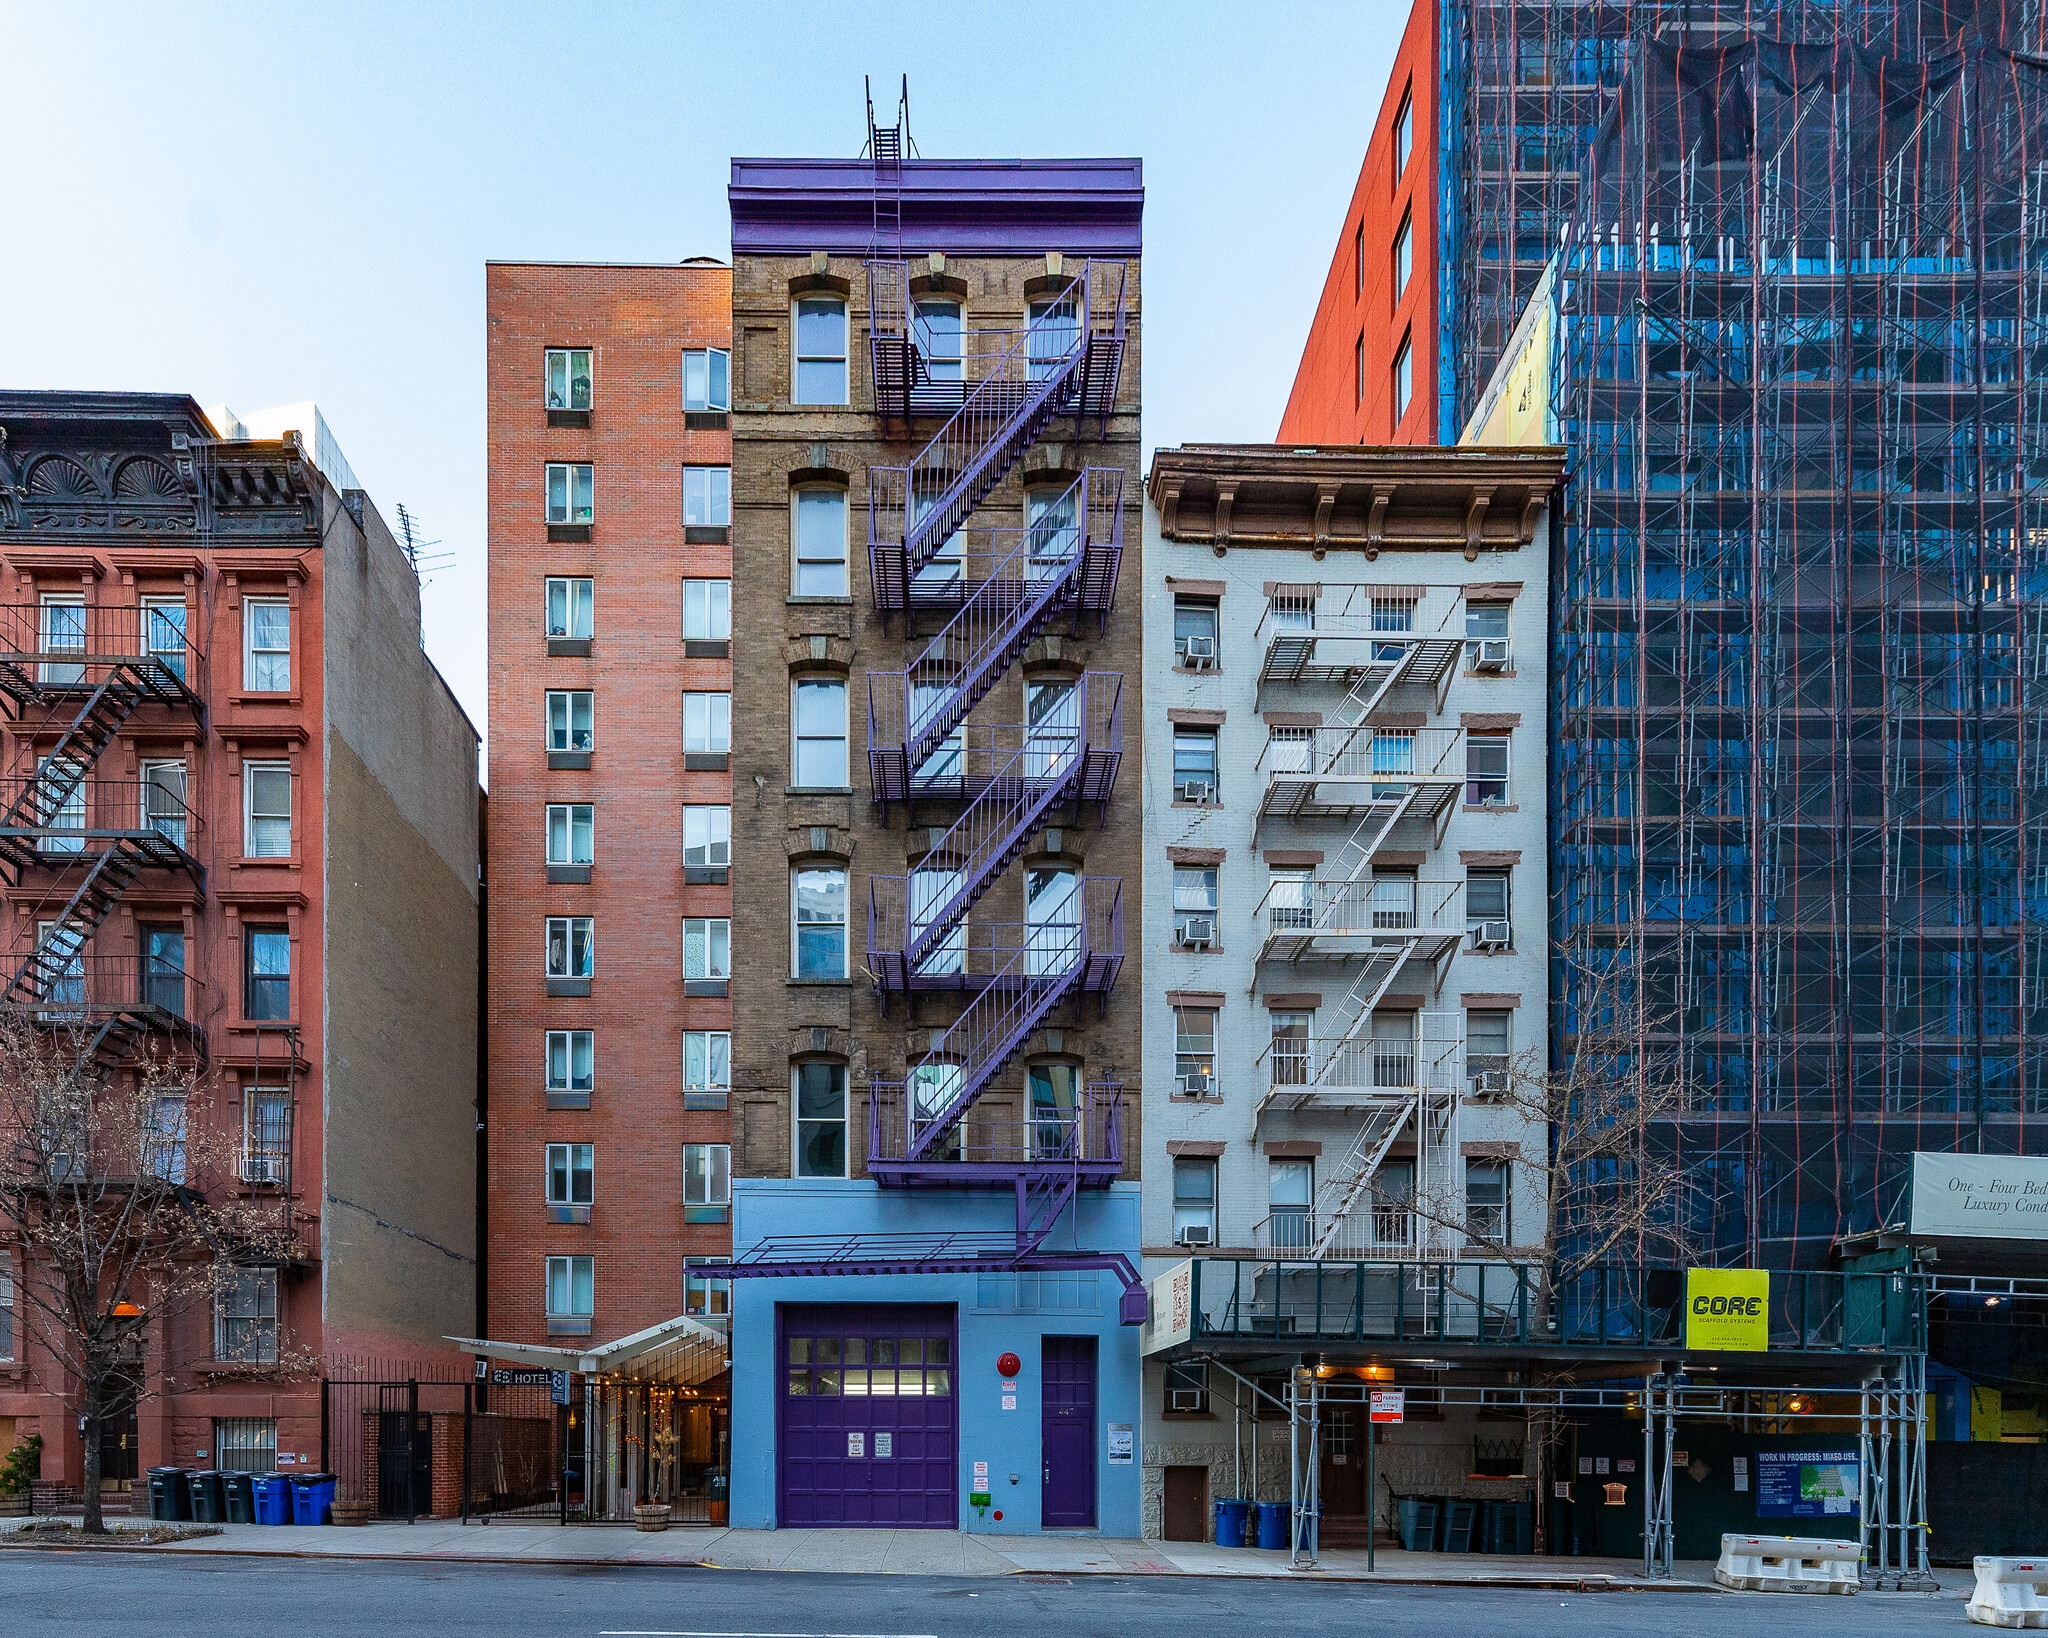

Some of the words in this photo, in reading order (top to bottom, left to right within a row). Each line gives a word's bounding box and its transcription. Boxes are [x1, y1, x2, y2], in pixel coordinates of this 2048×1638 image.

[1948, 1177, 1975, 1192] One
[1989, 1179, 2019, 1194] Four
[2022, 1180, 2048, 1196] Bed
[1963, 1195, 2010, 1215] Luxury
[2015, 1198, 2048, 1213] Cond
[1692, 1296, 1762, 1316] CORE
[514, 1374, 552, 1384] HOTEL
[552, 1392, 565, 1400] HOTEL
[1372, 1394, 1382, 1402] NO
[1759, 1453, 1778, 1462] WORK
[1779, 1453, 1786, 1462] IN
[1787, 1452, 1822, 1461] PROGRESS:
